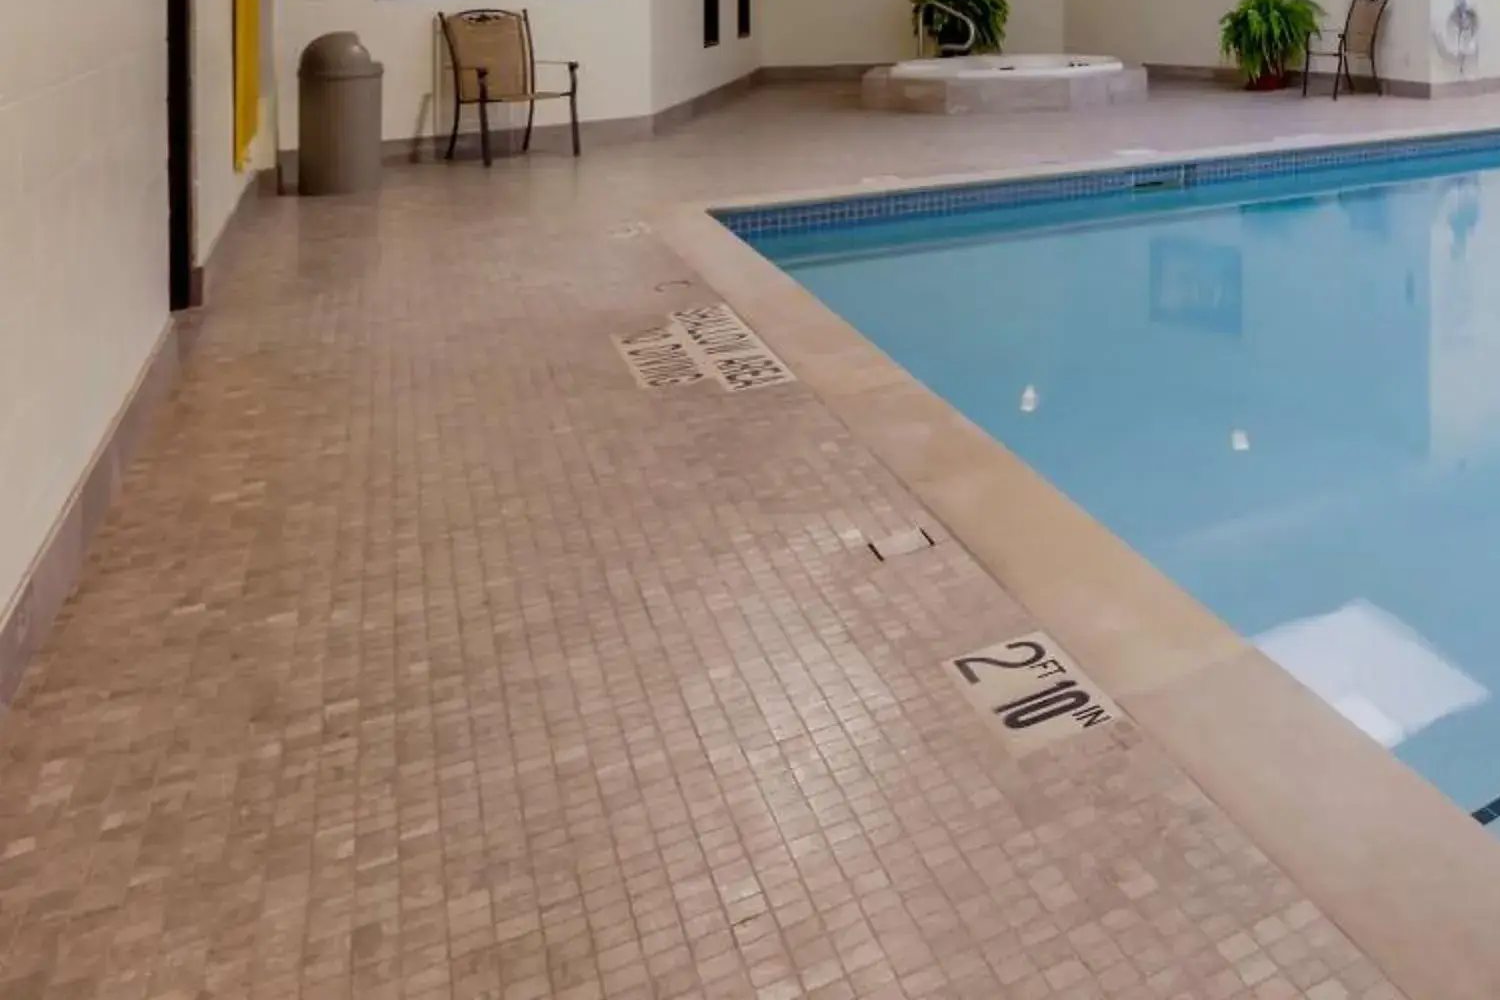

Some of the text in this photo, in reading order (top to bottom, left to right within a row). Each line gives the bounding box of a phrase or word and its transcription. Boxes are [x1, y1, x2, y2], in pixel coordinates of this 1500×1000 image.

[954, 641, 1112, 729] 2 FT 10 IN
